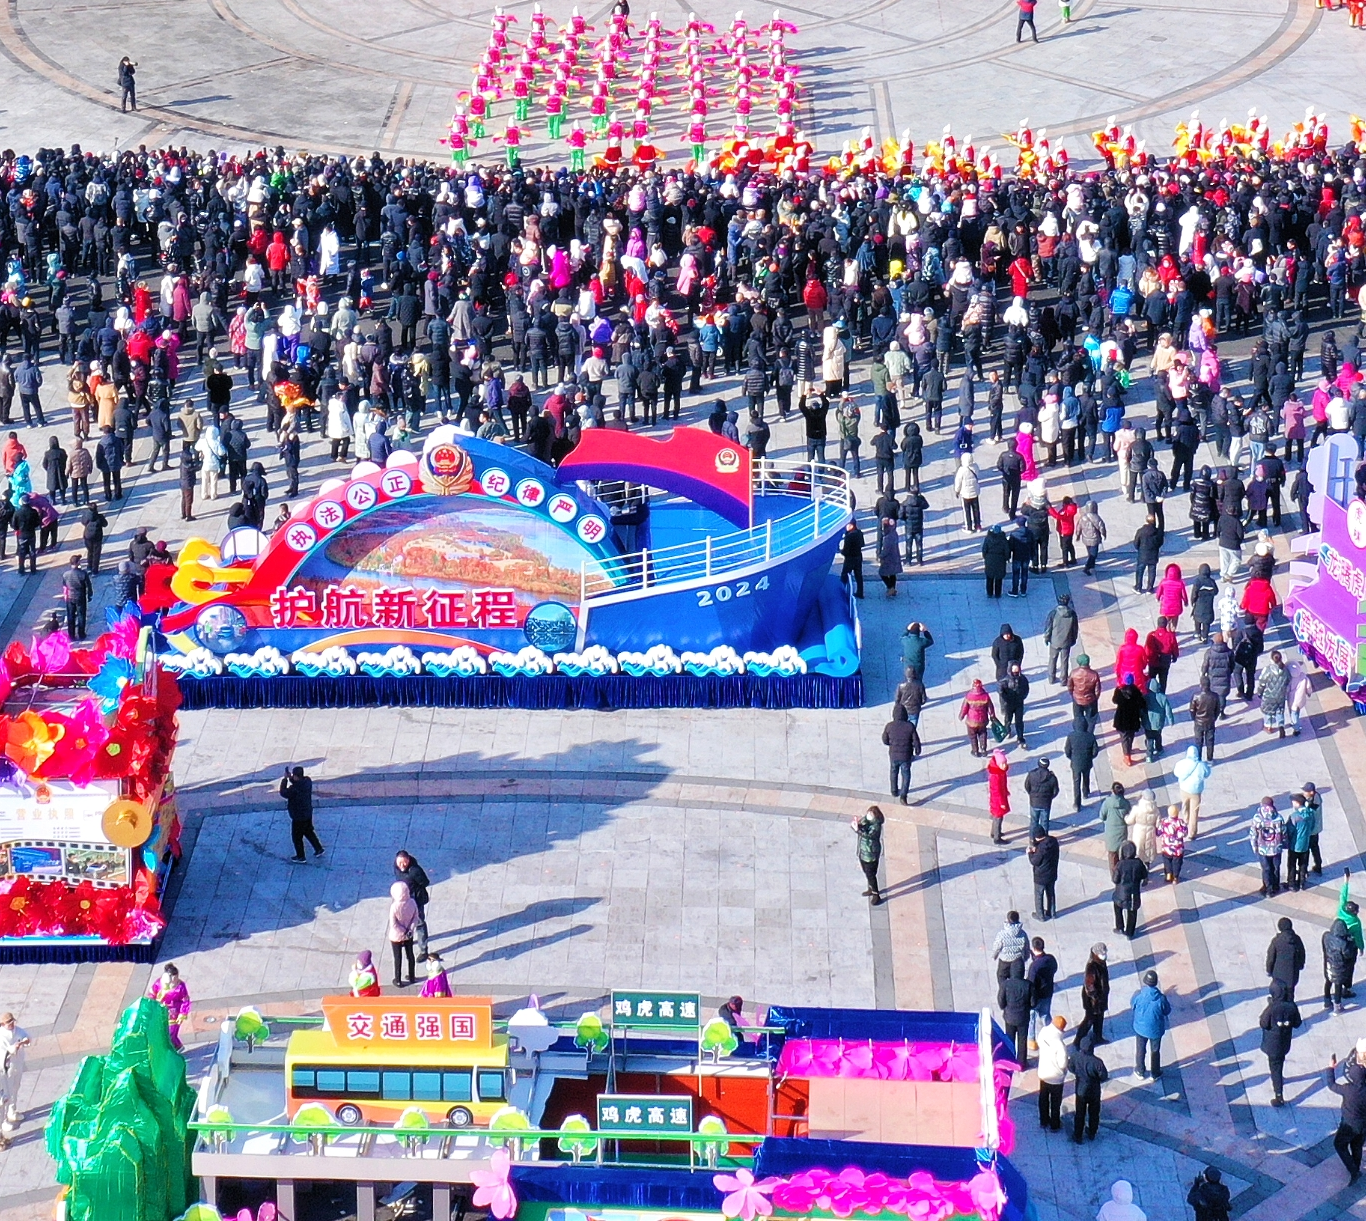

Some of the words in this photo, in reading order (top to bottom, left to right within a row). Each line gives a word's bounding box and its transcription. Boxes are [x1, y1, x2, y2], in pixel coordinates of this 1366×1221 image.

[290, 474, 408, 548] 执法公正
[488, 474, 604, 540] 纪律严明
[696, 575, 770, 607] 2024
[269, 584, 518, 630] 护航新征程
[1300, 608, 1351, 677] 跨越发展
[16, 808, 75, 821] 营业执照
[615, 999, 697, 1019] 鸡虎高速
[346, 1012, 477, 1041] 交通强国
[601, 1104, 688, 1125] 鸡虎高速
